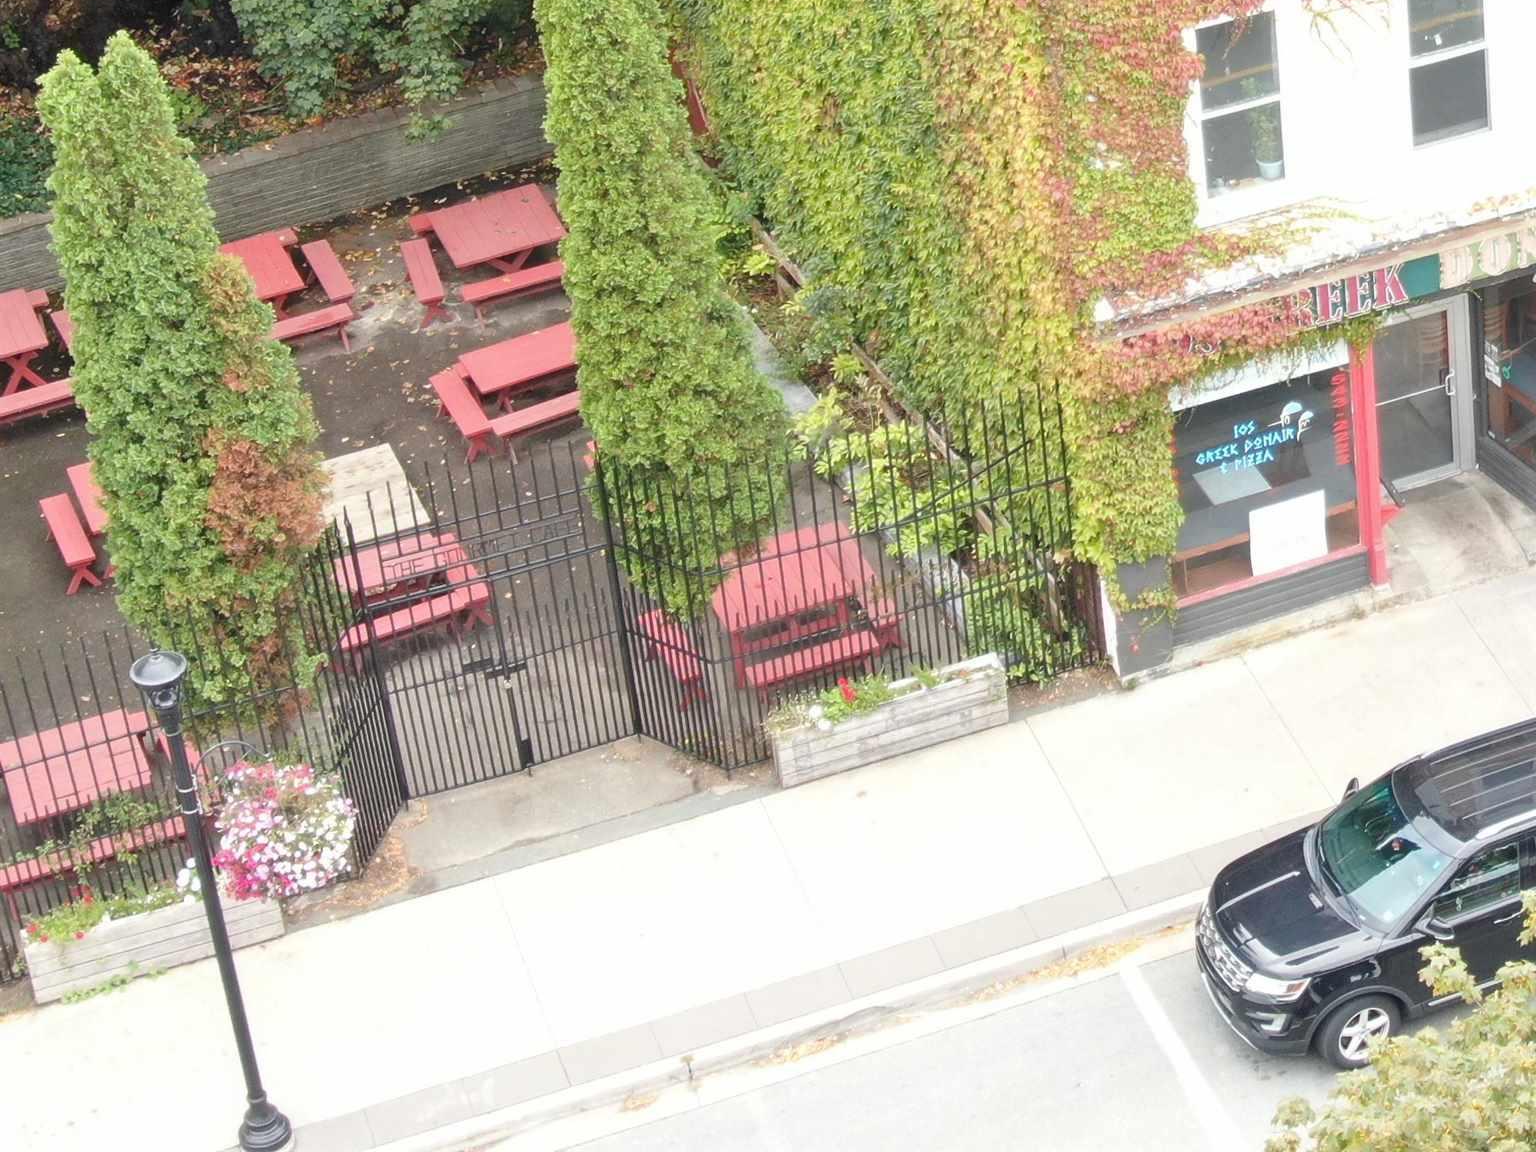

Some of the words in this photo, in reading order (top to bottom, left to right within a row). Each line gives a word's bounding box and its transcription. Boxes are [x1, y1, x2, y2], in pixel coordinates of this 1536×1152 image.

[1195, 442, 1240, 465] GREEK
[1244, 427, 1295, 452] DONAIR
[1234, 448, 1275, 472] PIZZA
[384, 556, 426, 580] THE
